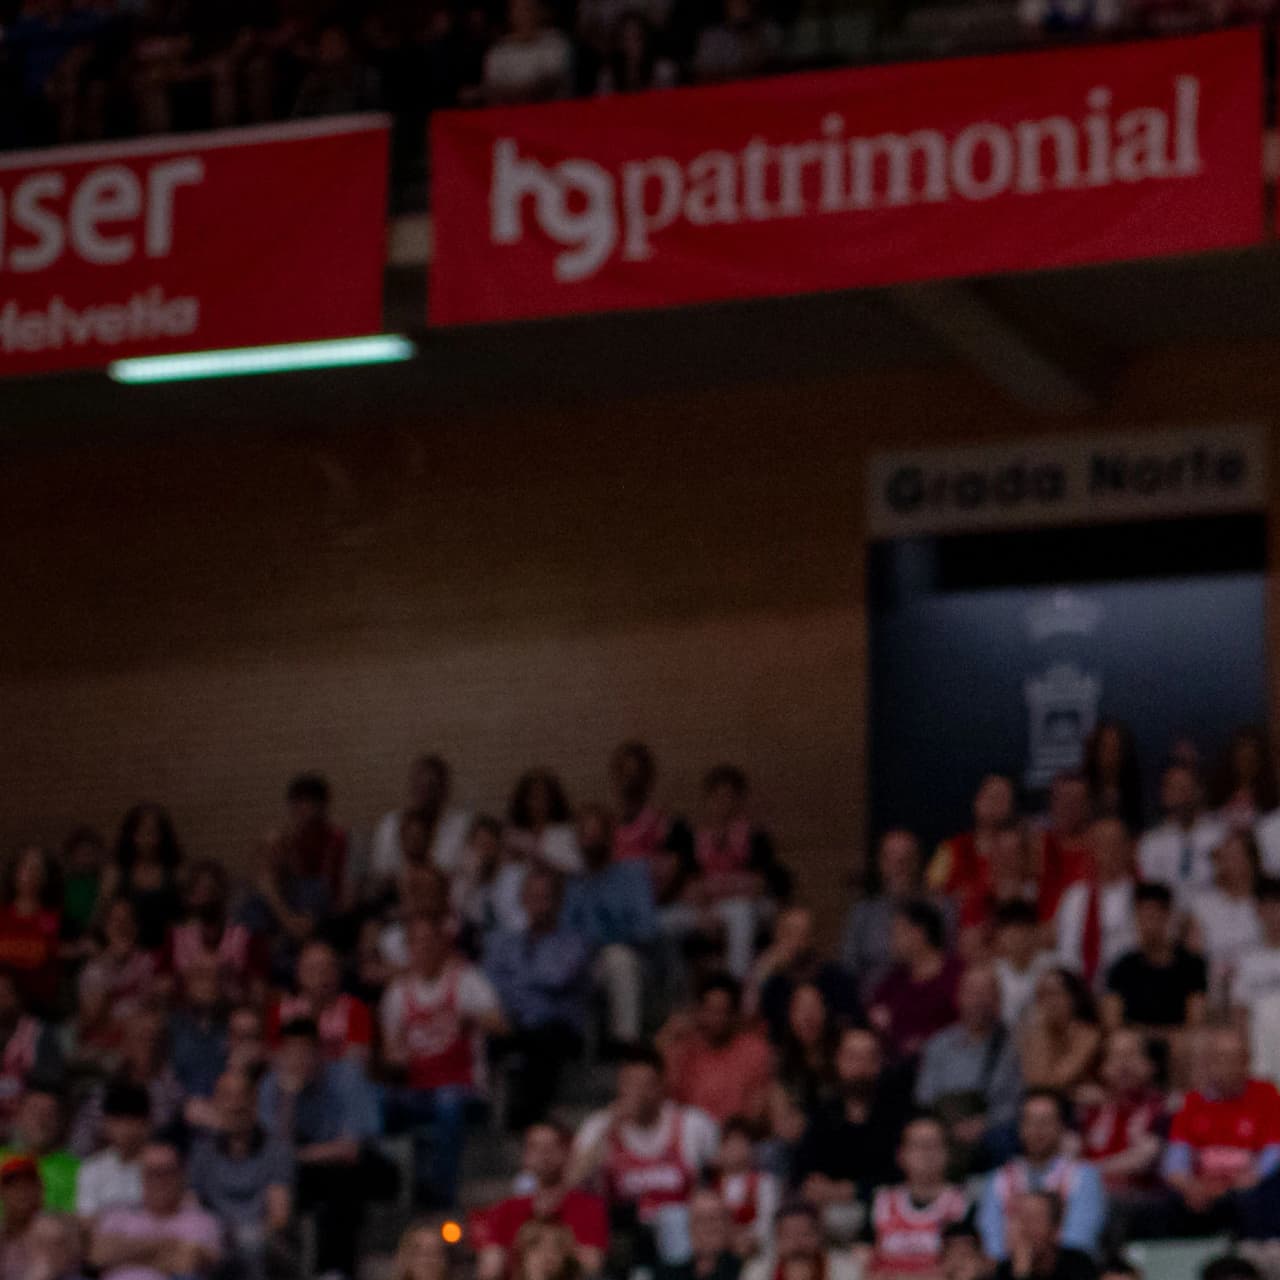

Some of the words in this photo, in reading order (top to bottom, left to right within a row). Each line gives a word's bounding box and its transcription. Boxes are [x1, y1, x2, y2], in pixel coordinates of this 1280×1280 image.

[0, 155, 206, 274] ser
[886, 458, 1068, 514] Grada
[1090, 444, 1246, 496] Norte
